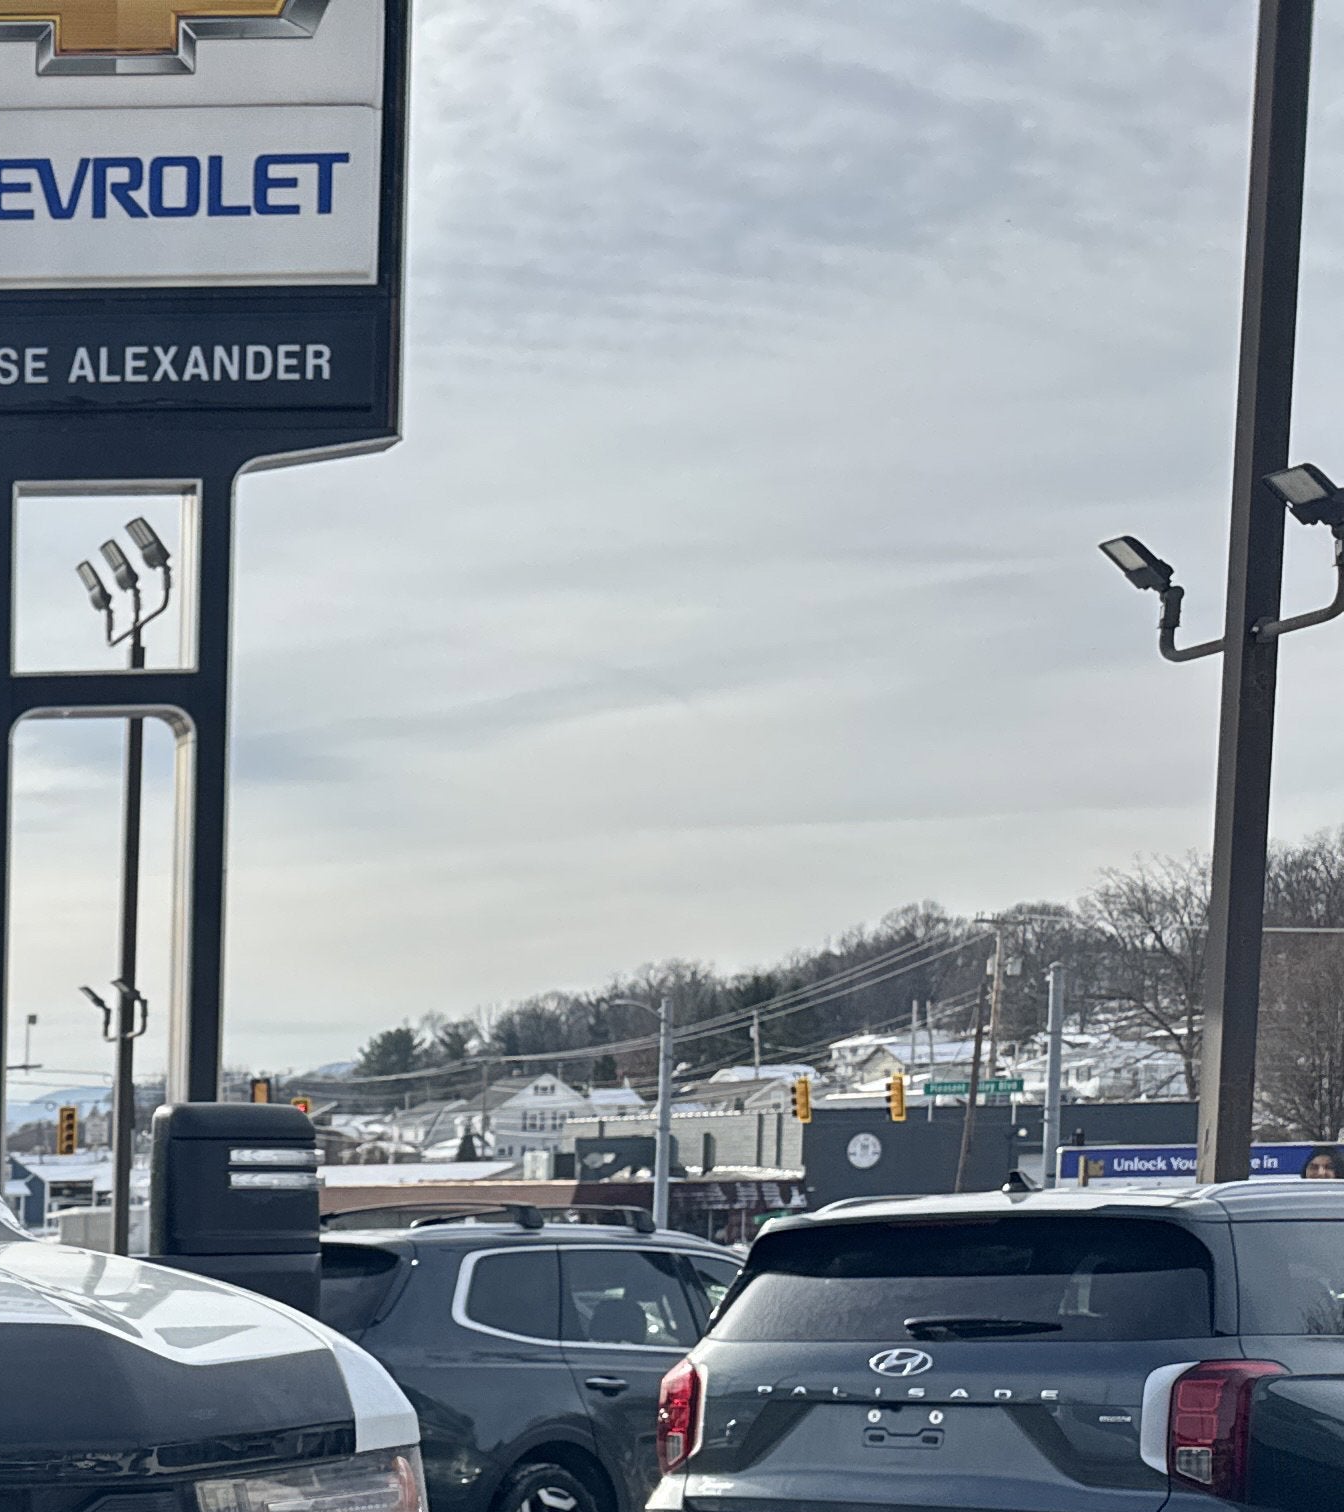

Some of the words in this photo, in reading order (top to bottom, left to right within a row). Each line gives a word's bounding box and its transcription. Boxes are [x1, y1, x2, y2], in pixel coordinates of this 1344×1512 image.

[67, 344, 333, 384] ALEXANDER
[1113, 1156, 1167, 1172] Unlock
[1169, 1155, 1197, 1170] You
[1263, 1156, 1279, 1170] in
[757, 1384, 1059, 1400] PALISADE
